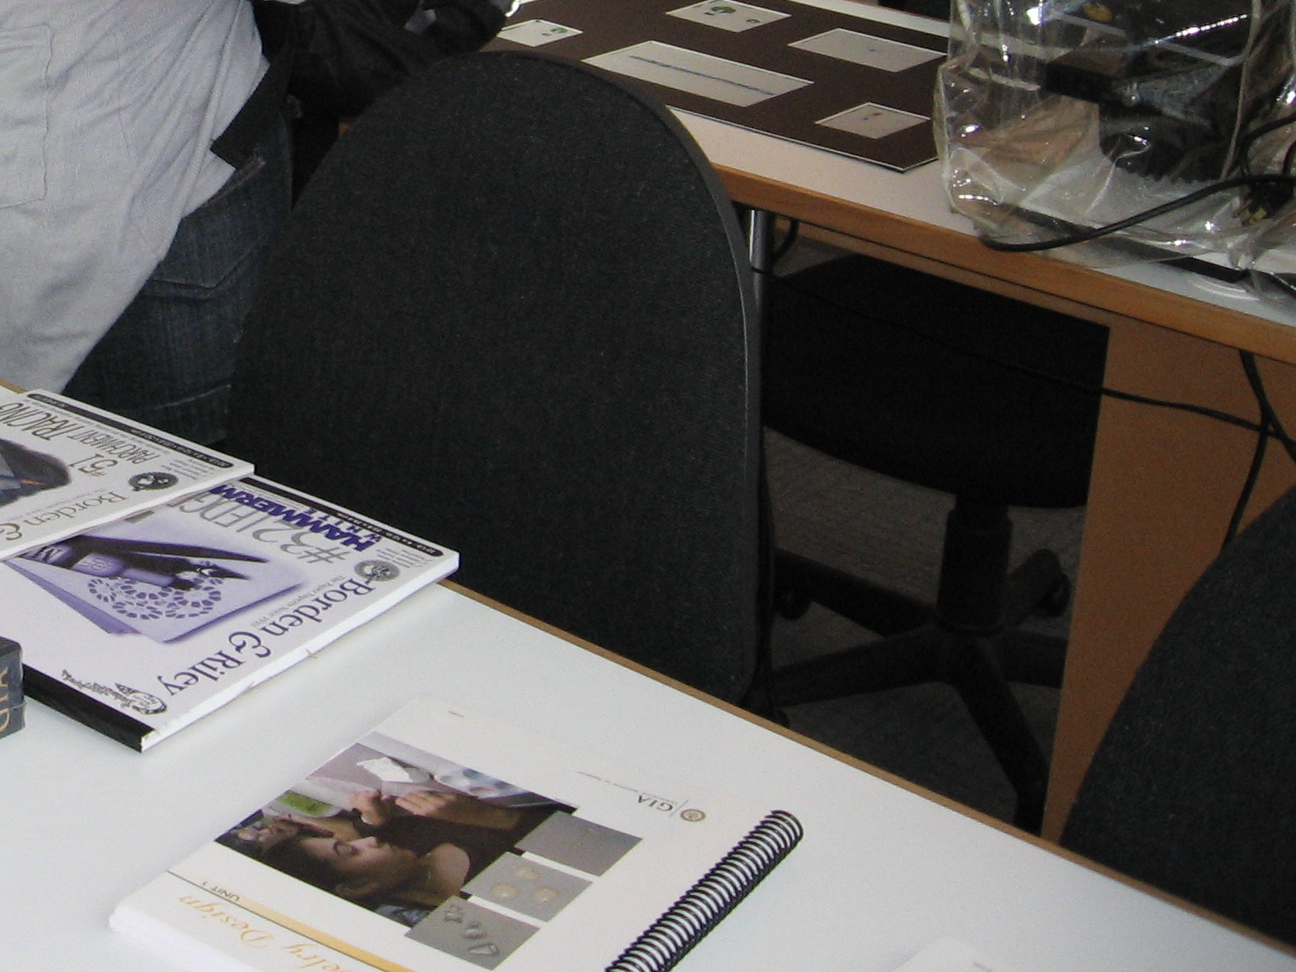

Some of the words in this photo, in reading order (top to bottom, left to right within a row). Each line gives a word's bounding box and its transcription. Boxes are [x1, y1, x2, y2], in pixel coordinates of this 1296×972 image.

[66, 429, 161, 465] PARCHMENT
[23, 490, 129, 527] Borden
[209, 484, 375, 552] HAMMERM
[304, 507, 383, 543] WHITE
[251, 519, 351, 564] #32
[260, 577, 376, 637] Borden
[229, 630, 272, 658] &
[157, 650, 246, 697] Riley
[637, 794, 674, 812] GIA
[211, 885, 241, 902] UNIT
[179, 895, 275, 949] Design
[281, 943, 354, 972] elry
